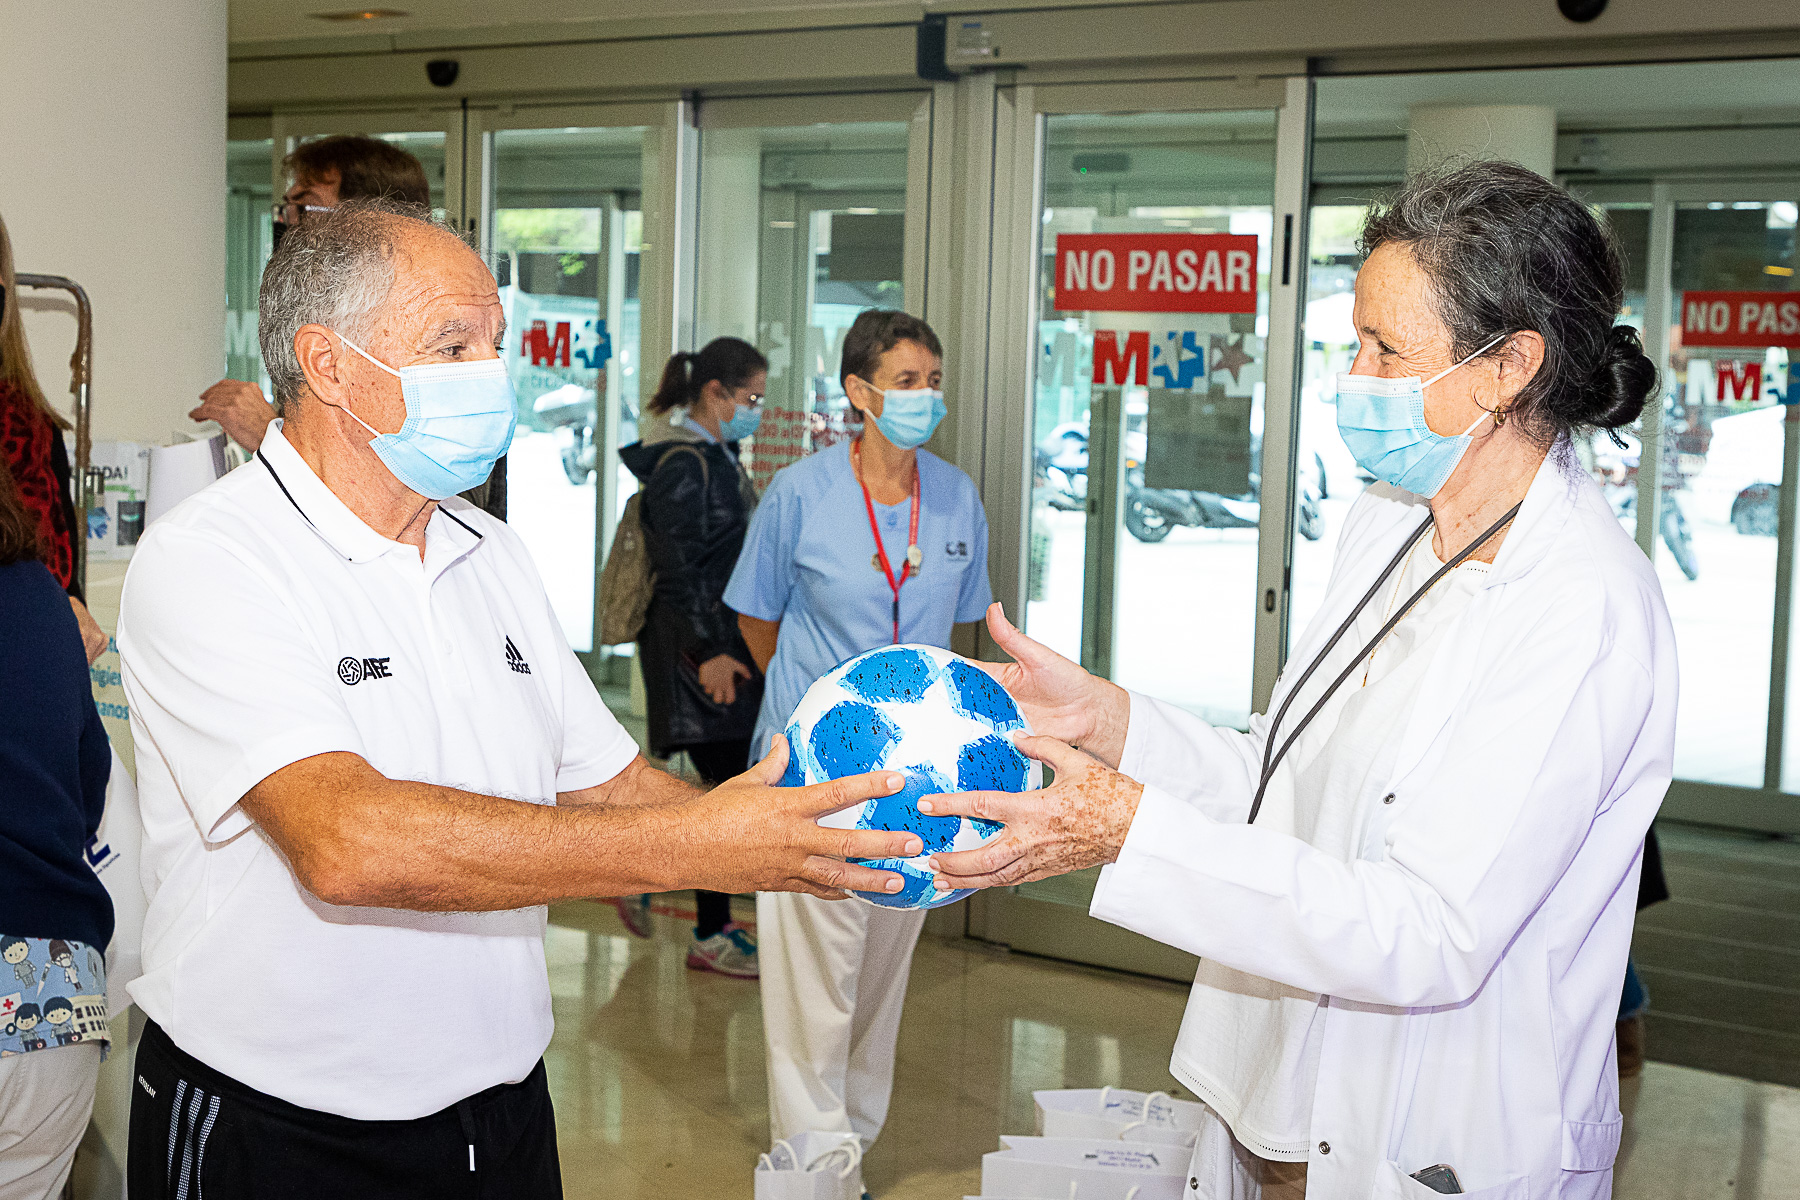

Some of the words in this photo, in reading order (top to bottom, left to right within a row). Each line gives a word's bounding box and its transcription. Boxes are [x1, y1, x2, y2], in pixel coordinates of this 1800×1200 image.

[1065, 249, 1115, 291] NO
[1127, 249, 1251, 292] PASAR
[1686, 301, 1730, 334] NO
[1739, 301, 1800, 335] PAS
[362, 657, 393, 680] AFE
